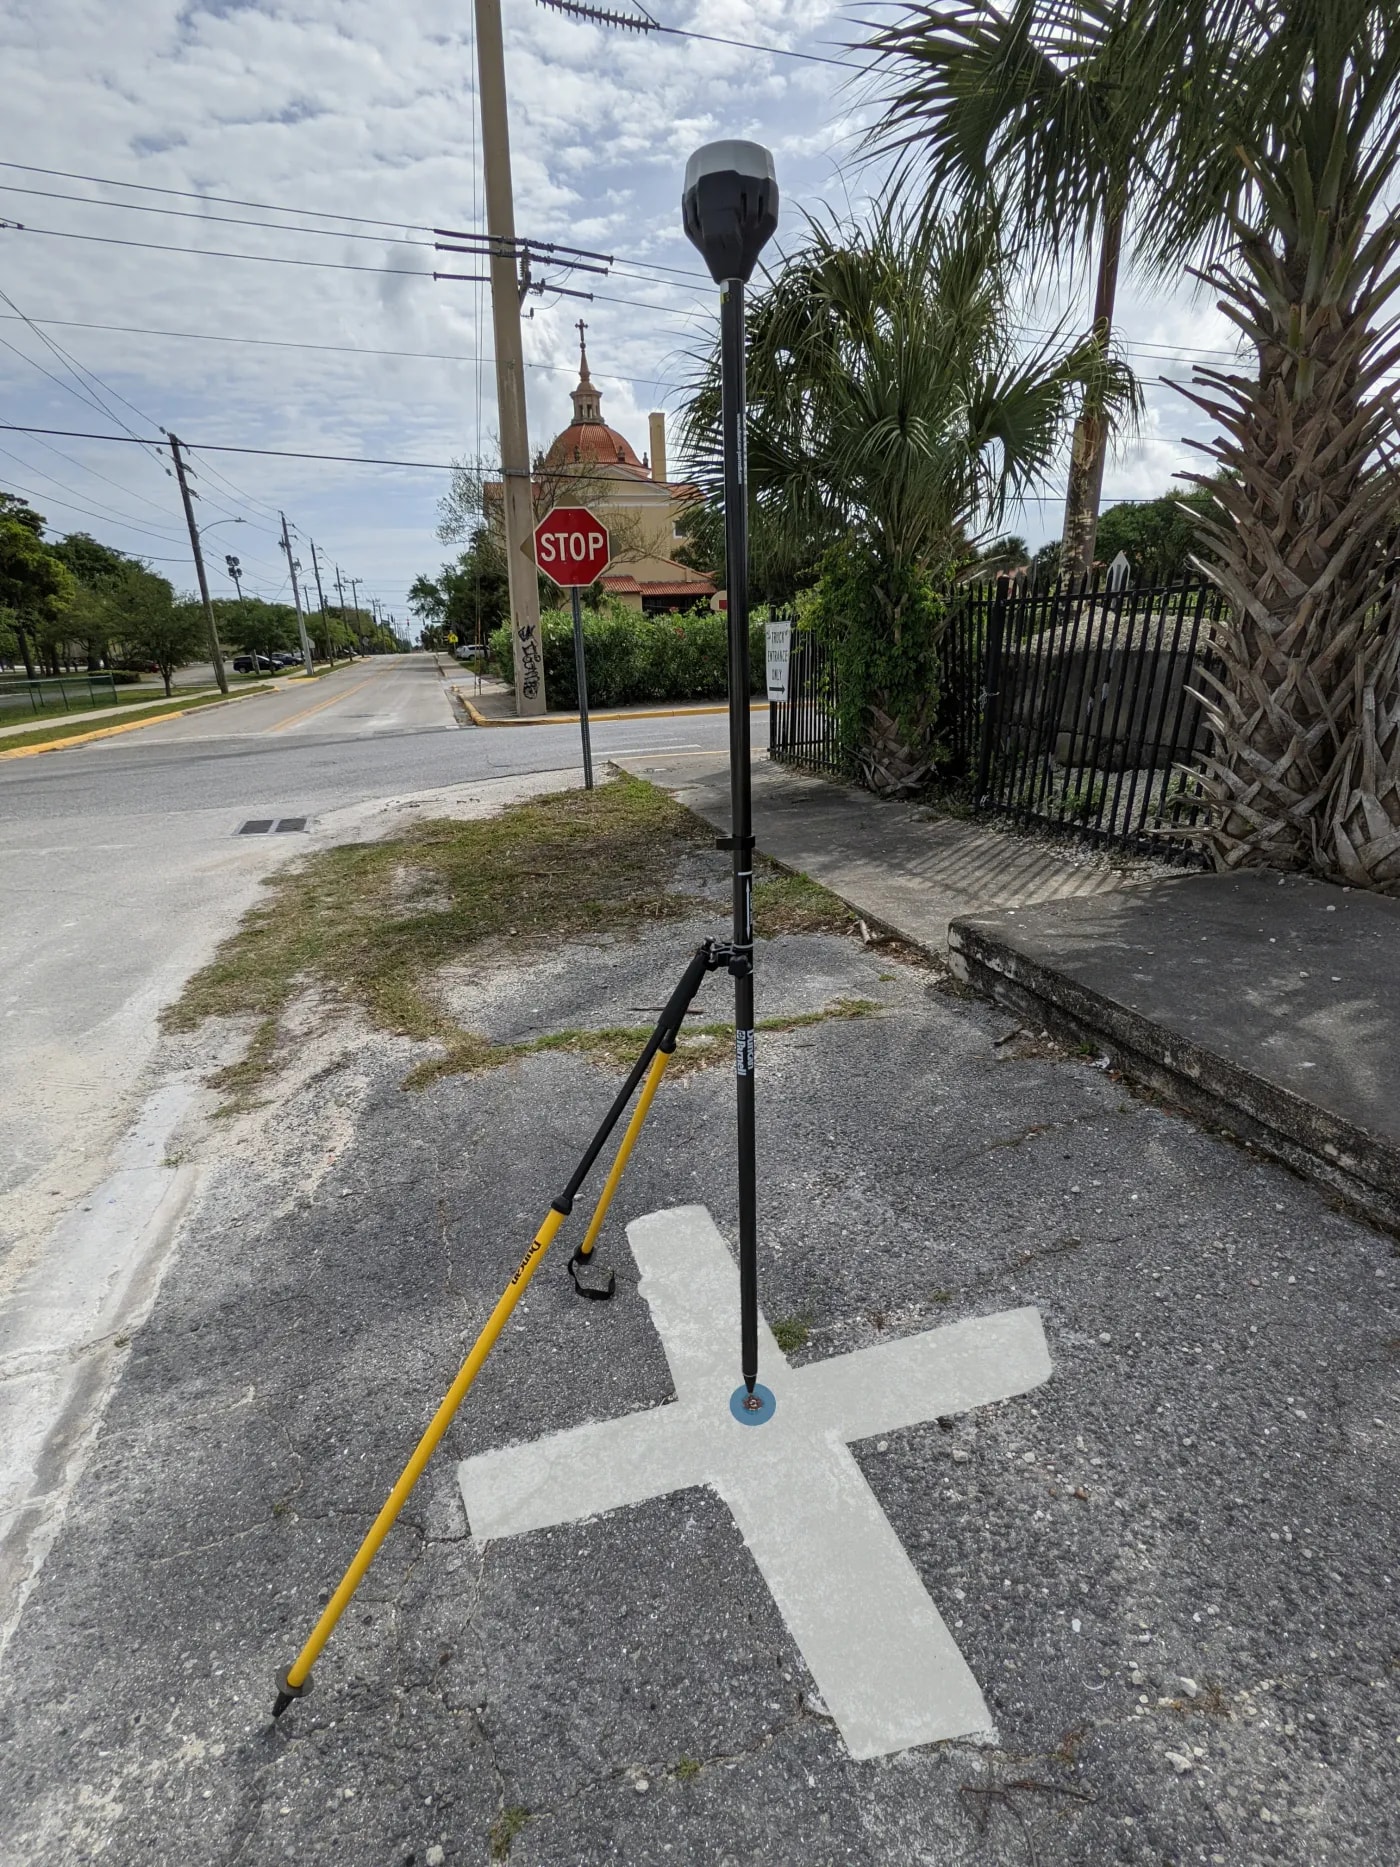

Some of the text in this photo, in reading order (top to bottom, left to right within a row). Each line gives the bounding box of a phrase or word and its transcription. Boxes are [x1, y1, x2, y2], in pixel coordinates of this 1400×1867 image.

[541, 532, 604, 562] STOP
[767, 650, 788, 663] ENTRANCE
[771, 668, 782, 681] ONLY
[737, 1040, 747, 1076] Parnell
[511, 1240, 541, 1285] Duncan
